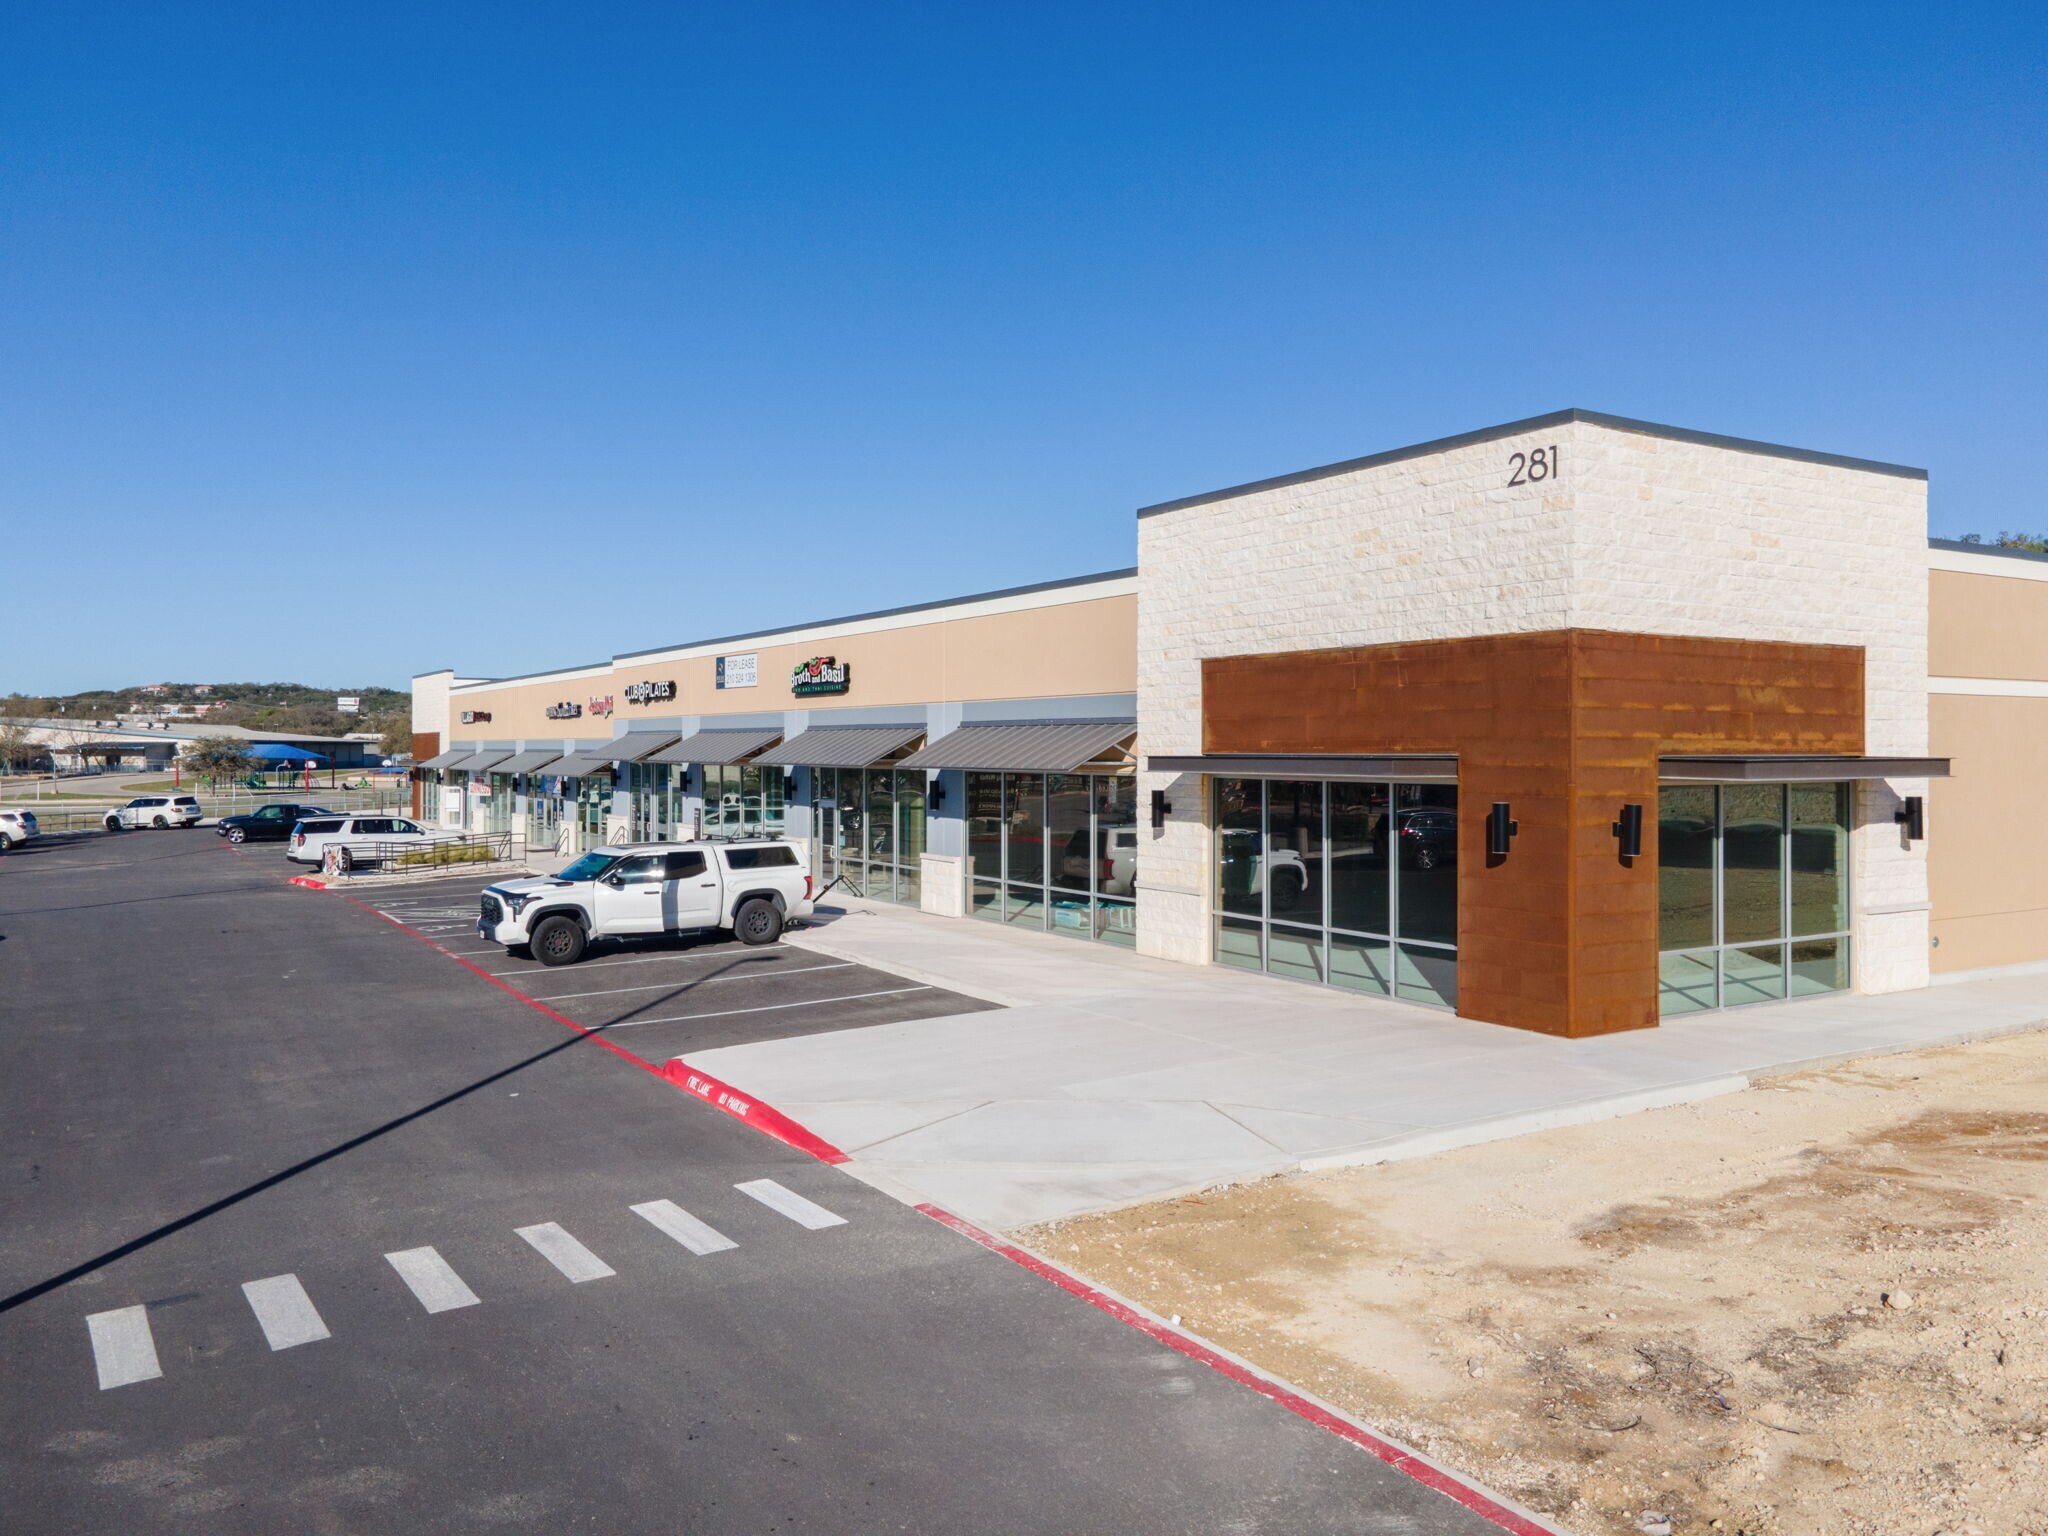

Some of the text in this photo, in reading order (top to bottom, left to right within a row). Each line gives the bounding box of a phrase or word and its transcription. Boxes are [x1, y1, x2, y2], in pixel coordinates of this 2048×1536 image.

[1507, 445, 1557, 488] 281
[728, 657, 754, 670] FOR LEASE
[791, 667, 811, 686] Broth
[821, 664, 844, 682] Basil
[624, 681, 669, 699] CLUB PILATES
[686, 1075, 714, 1096] FIRE LANE
[718, 1092, 750, 1116] NO PARKING
